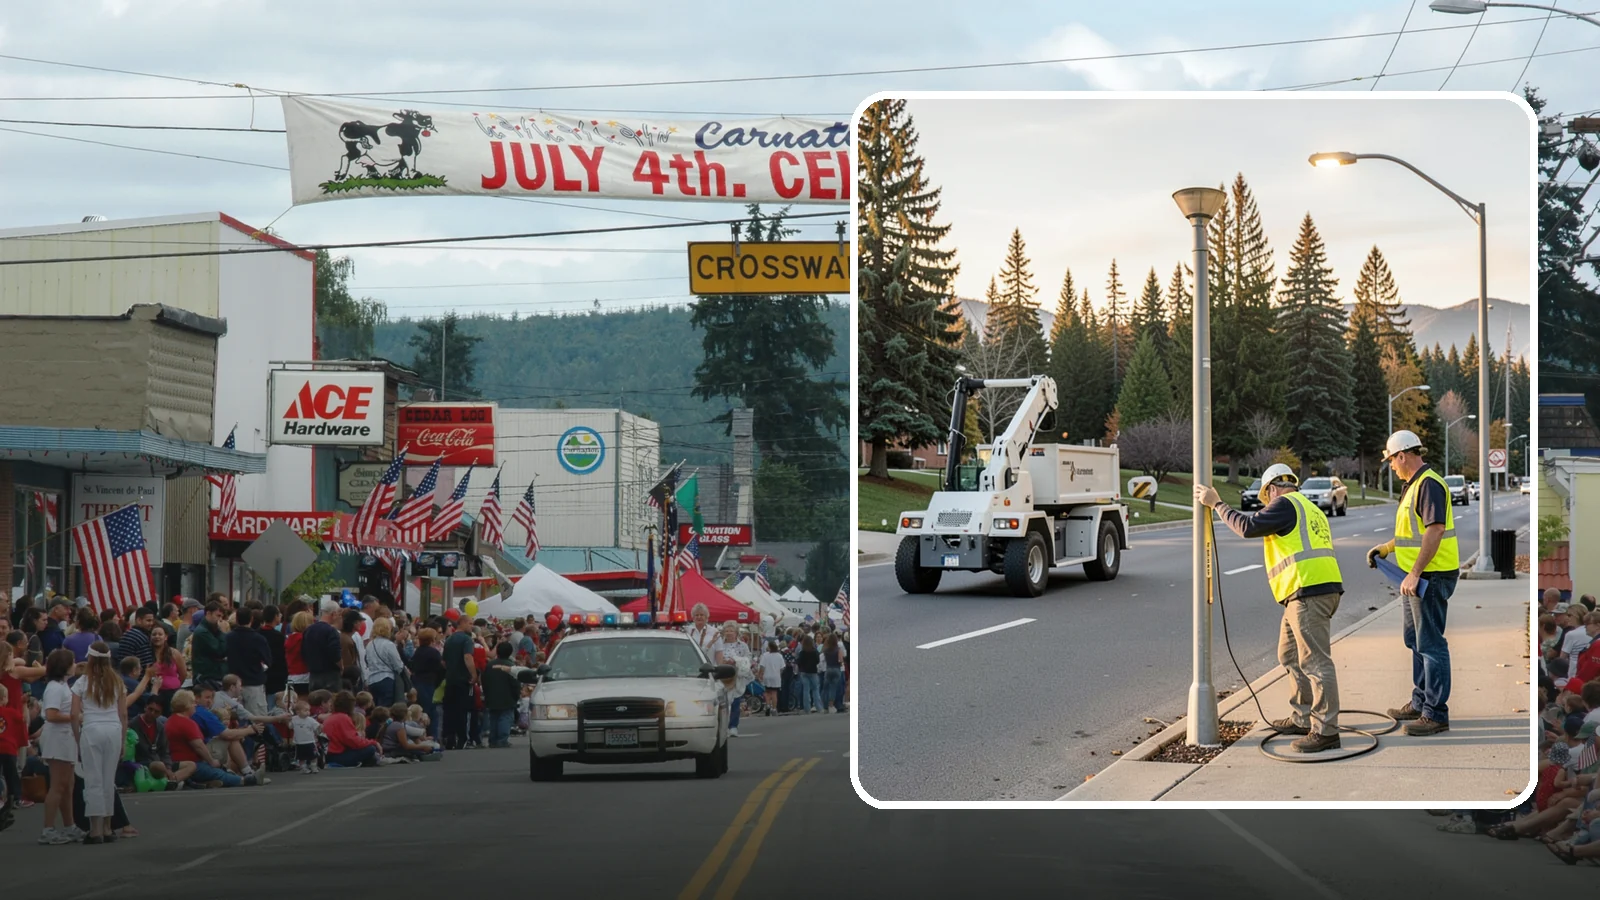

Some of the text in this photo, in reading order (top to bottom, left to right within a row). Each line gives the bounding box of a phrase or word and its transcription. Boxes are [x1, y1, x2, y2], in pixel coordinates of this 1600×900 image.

[695, 121, 850, 149] Carnat
[481, 141, 604, 191] JULY
[632, 150, 746, 197] 4th.
[697, 254, 850, 280] CROSSWA
[283, 380, 373, 419] ACE
[405, 409, 485, 421] CEDAR LOG
[284, 421, 371, 436] Hardware
[353, 467, 385, 480] Simpl
[96, 485, 124, 494] Vincent
[126, 486, 136, 495] de
[137, 486, 155, 495] Paul
[81, 503, 153, 522] THT
[213, 517, 330, 535] HARDARE
[688, 527, 741, 535] CRNATION
